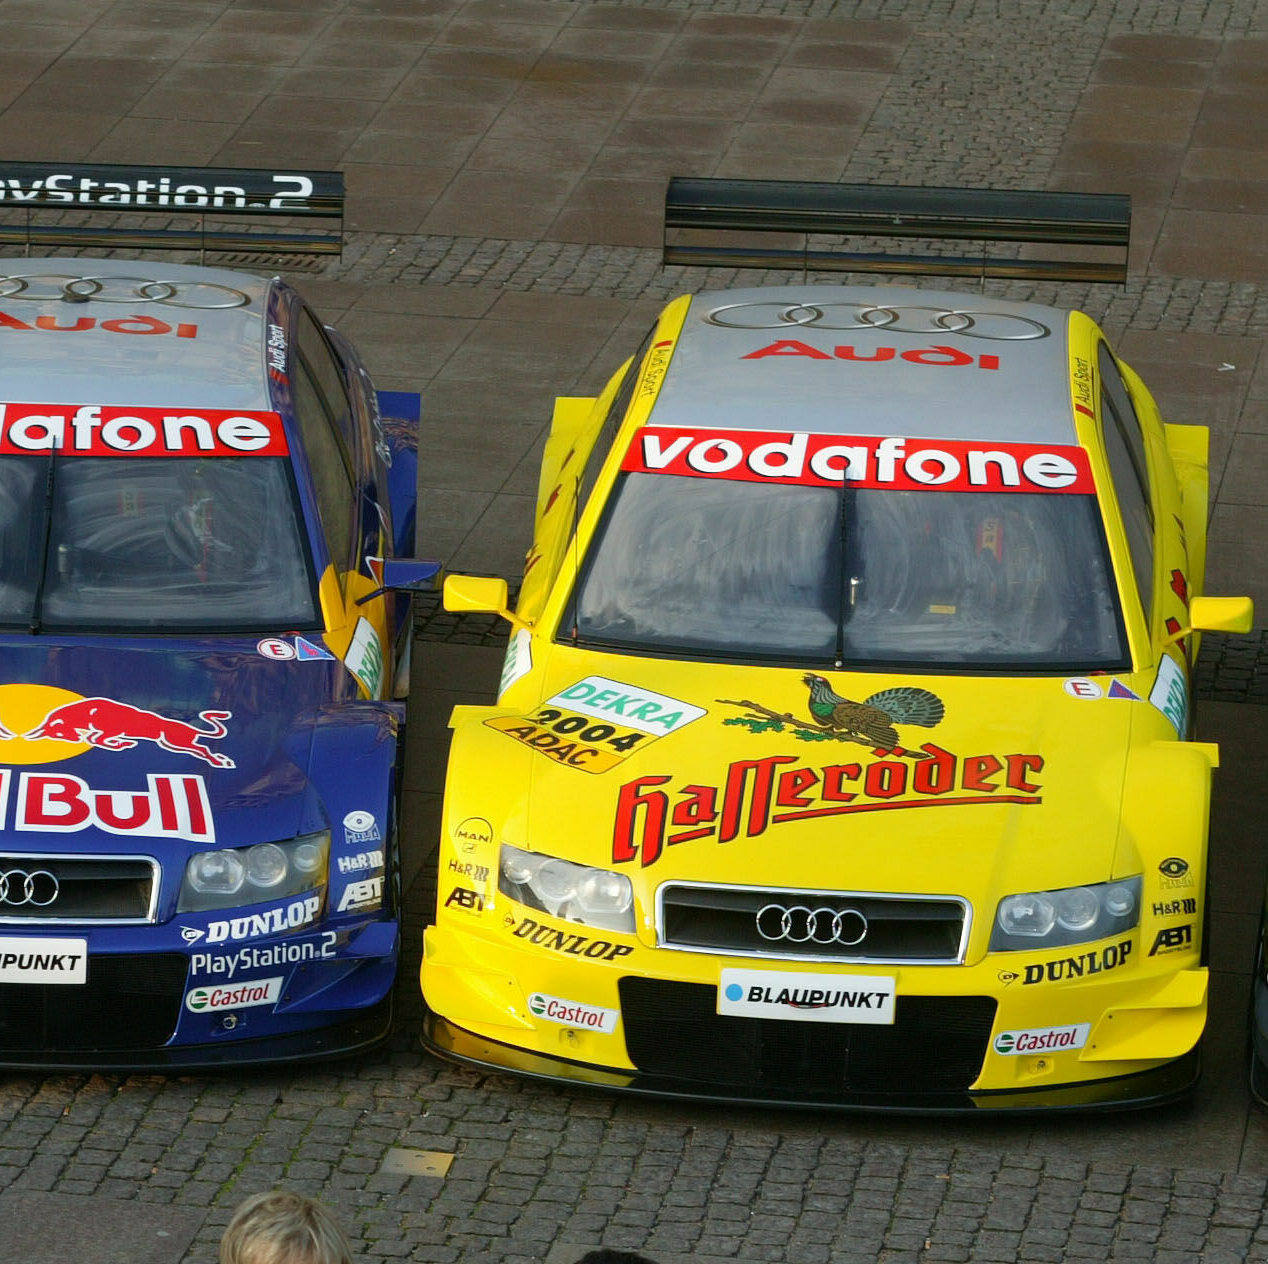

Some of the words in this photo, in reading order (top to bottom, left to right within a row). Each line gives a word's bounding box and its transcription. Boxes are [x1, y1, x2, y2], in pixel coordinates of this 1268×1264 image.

[740, 338, 1000, 370] Audi
[643, 433, 1077, 489] vodafone
[557, 682, 684, 730] DEKRA
[504, 723, 600, 766] ADAC
[525, 708, 647, 753] 2004
[18, 773, 213, 841] Bull
[456, 829, 491, 843] MAN
[205, 896, 321, 944] DUNLOP
[512, 917, 635, 962] DUNLOP
[1147, 924, 1193, 958] ABT
[191, 942, 314, 978] PlayStation
[320, 930, 337, 957] 2
[1022, 940, 1133, 985] DUNLOP
[210, 983, 270, 1007] Castrol
[547, 1000, 606, 1029] Castrol
[747, 986, 890, 1009] BLAUPUNKT
[1015, 1028, 1078, 1052] Castrol
